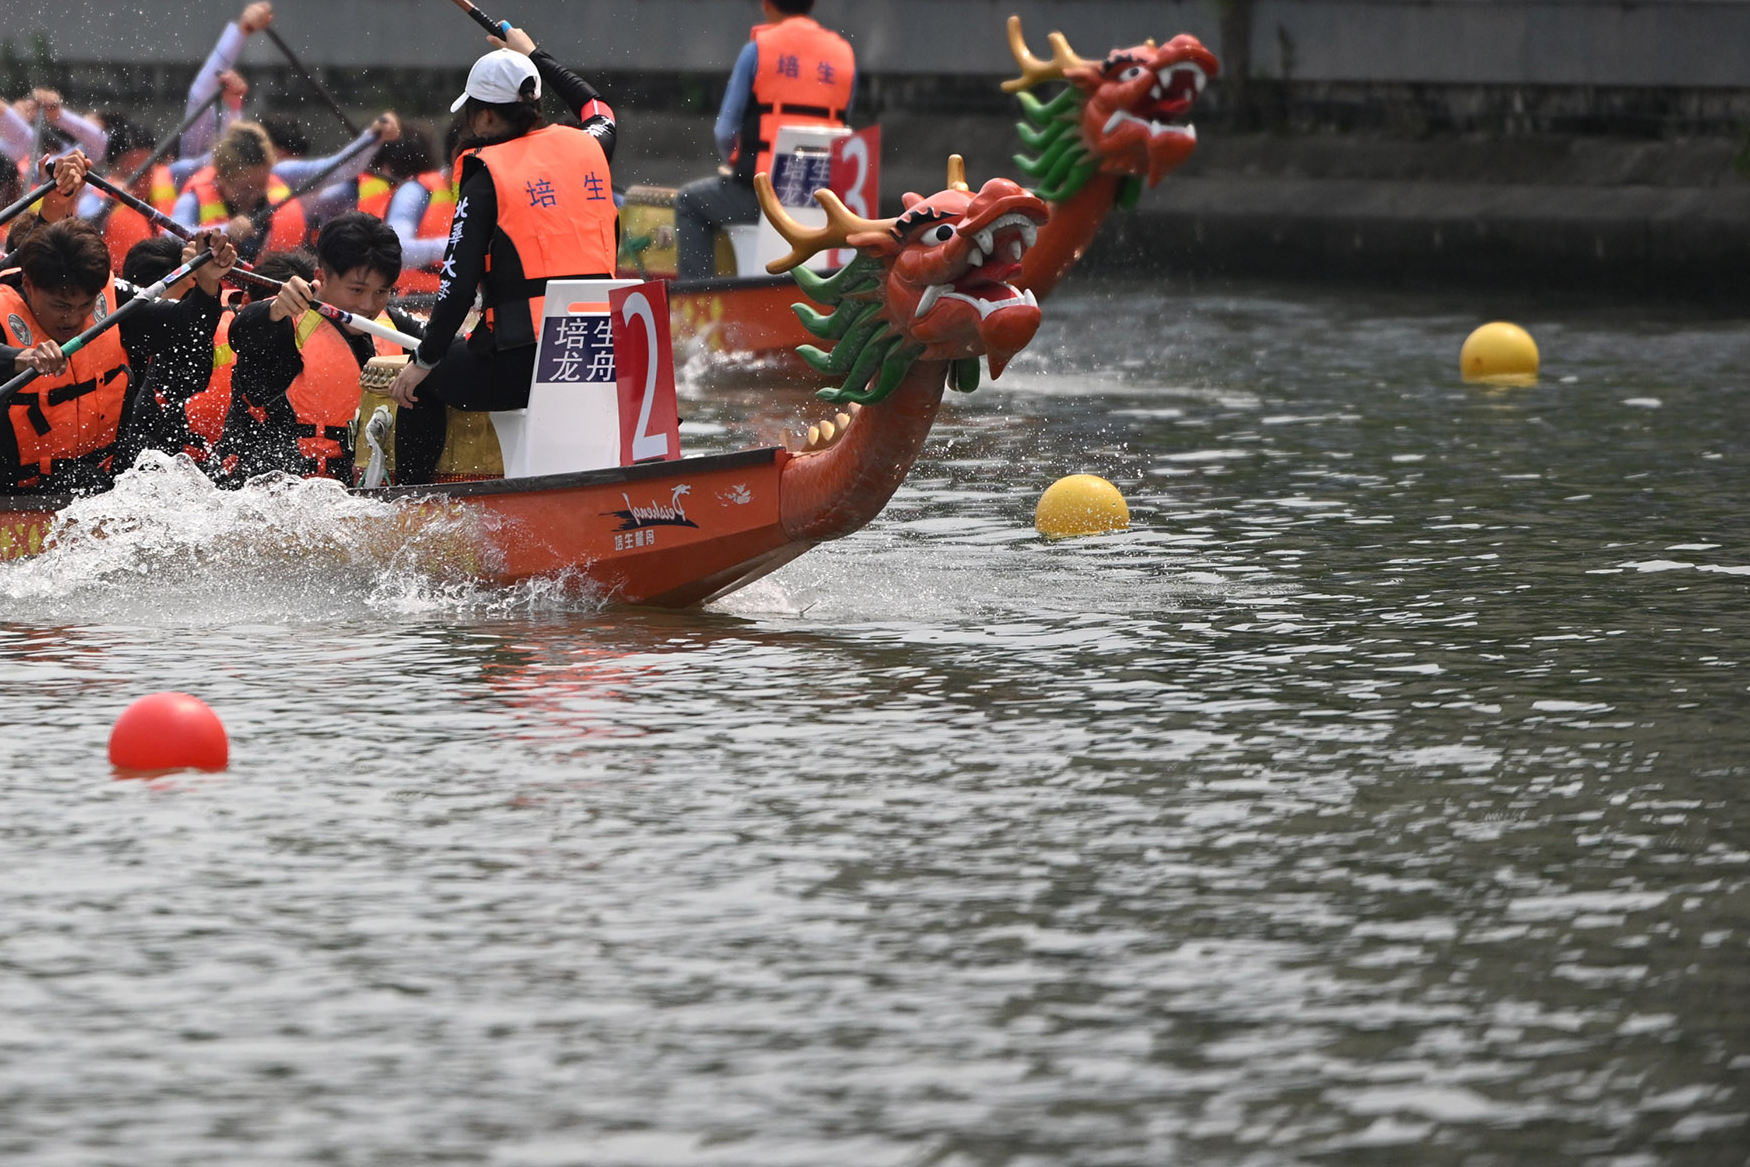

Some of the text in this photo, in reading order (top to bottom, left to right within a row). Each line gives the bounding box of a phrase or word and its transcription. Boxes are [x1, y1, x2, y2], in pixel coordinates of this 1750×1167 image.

[525, 171, 607, 209] 培生
[553, 317, 615, 350] 培生
[548, 350, 617, 383] 龙舟
[621, 291, 669, 462] 2
